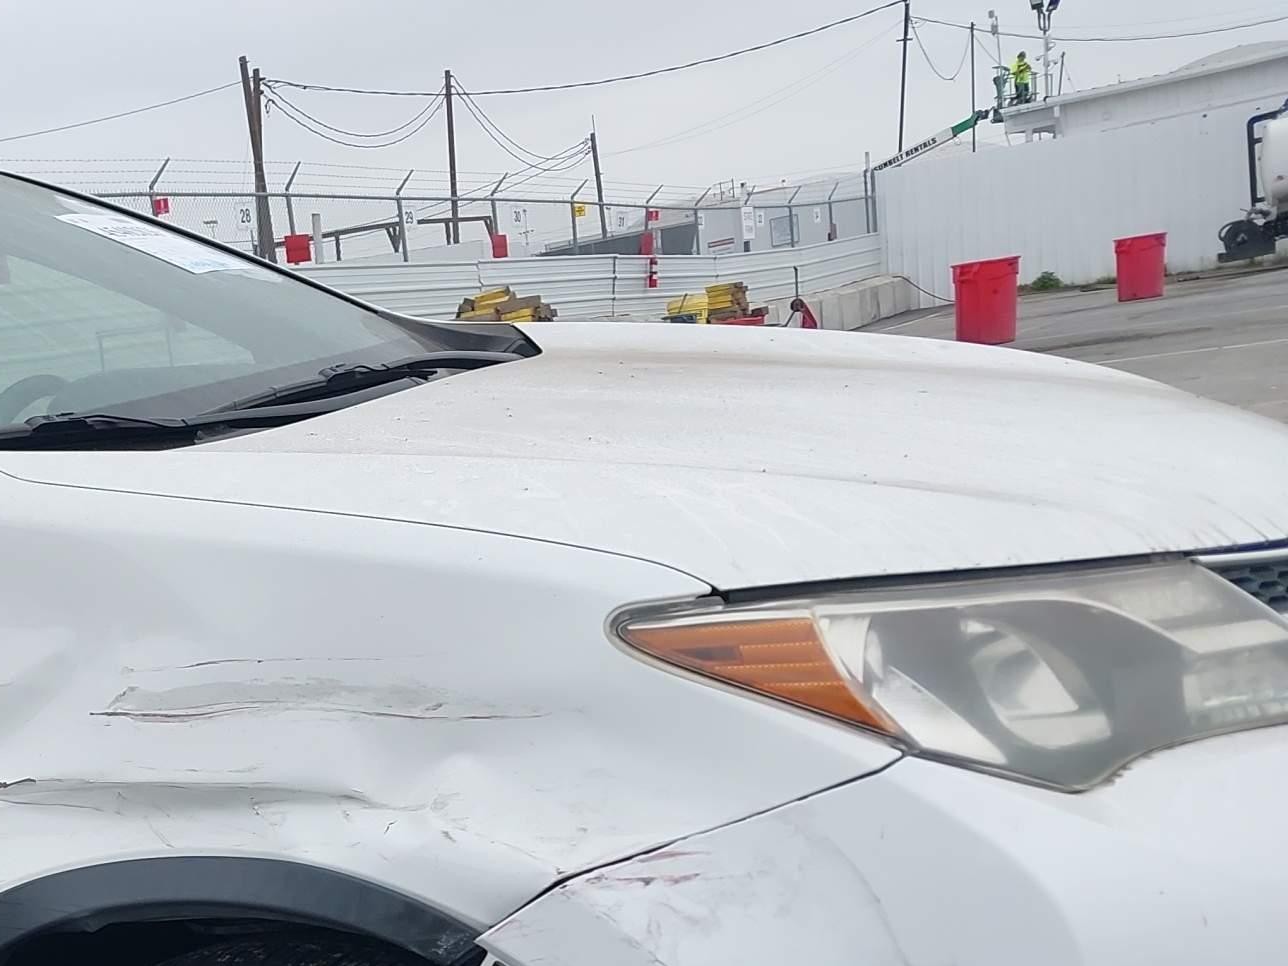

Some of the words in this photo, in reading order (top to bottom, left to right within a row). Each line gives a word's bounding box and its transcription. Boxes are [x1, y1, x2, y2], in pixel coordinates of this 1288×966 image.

[905, 137, 937, 158] RENTALS
[239, 208, 252, 224] 28
[404, 210, 413, 225] 29
[513, 210, 522, 223] 30
